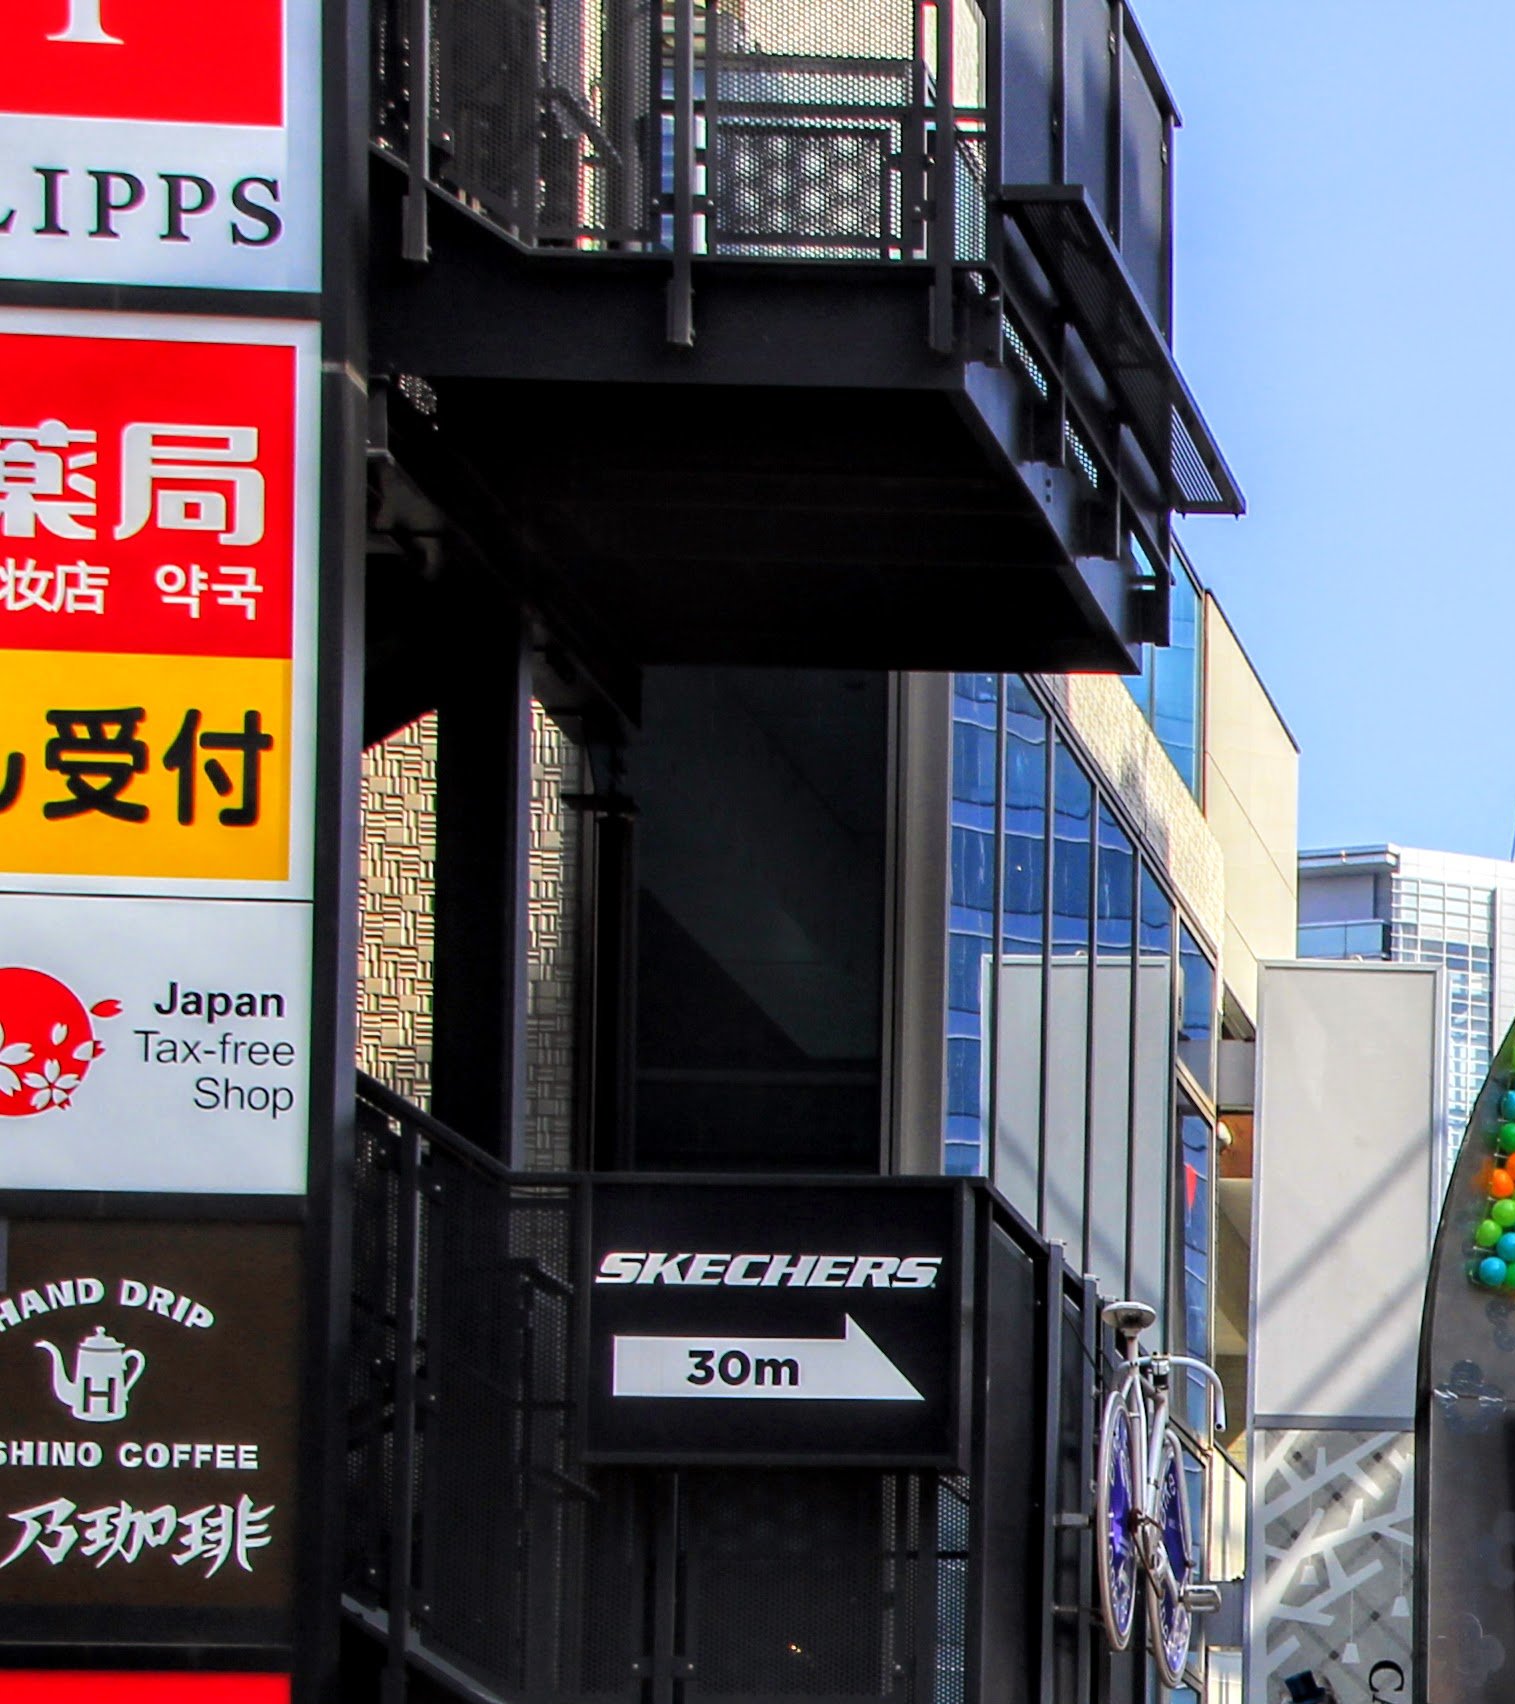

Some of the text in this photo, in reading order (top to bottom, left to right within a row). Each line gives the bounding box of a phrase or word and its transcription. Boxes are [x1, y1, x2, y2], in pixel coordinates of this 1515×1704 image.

[0, 167, 284, 247] IPPS
[155, 562, 264, 620] 약국
[154, 980, 285, 1021] Japan
[134, 1029, 296, 1067] Tax-free
[193, 1076, 295, 1119] Shop
[596, 1252, 942, 1289] SKECHERS
[120, 1278, 215, 1331] DRIP
[686, 1349, 800, 1386] 30m
[119, 1443, 259, 1471] COFFEE
